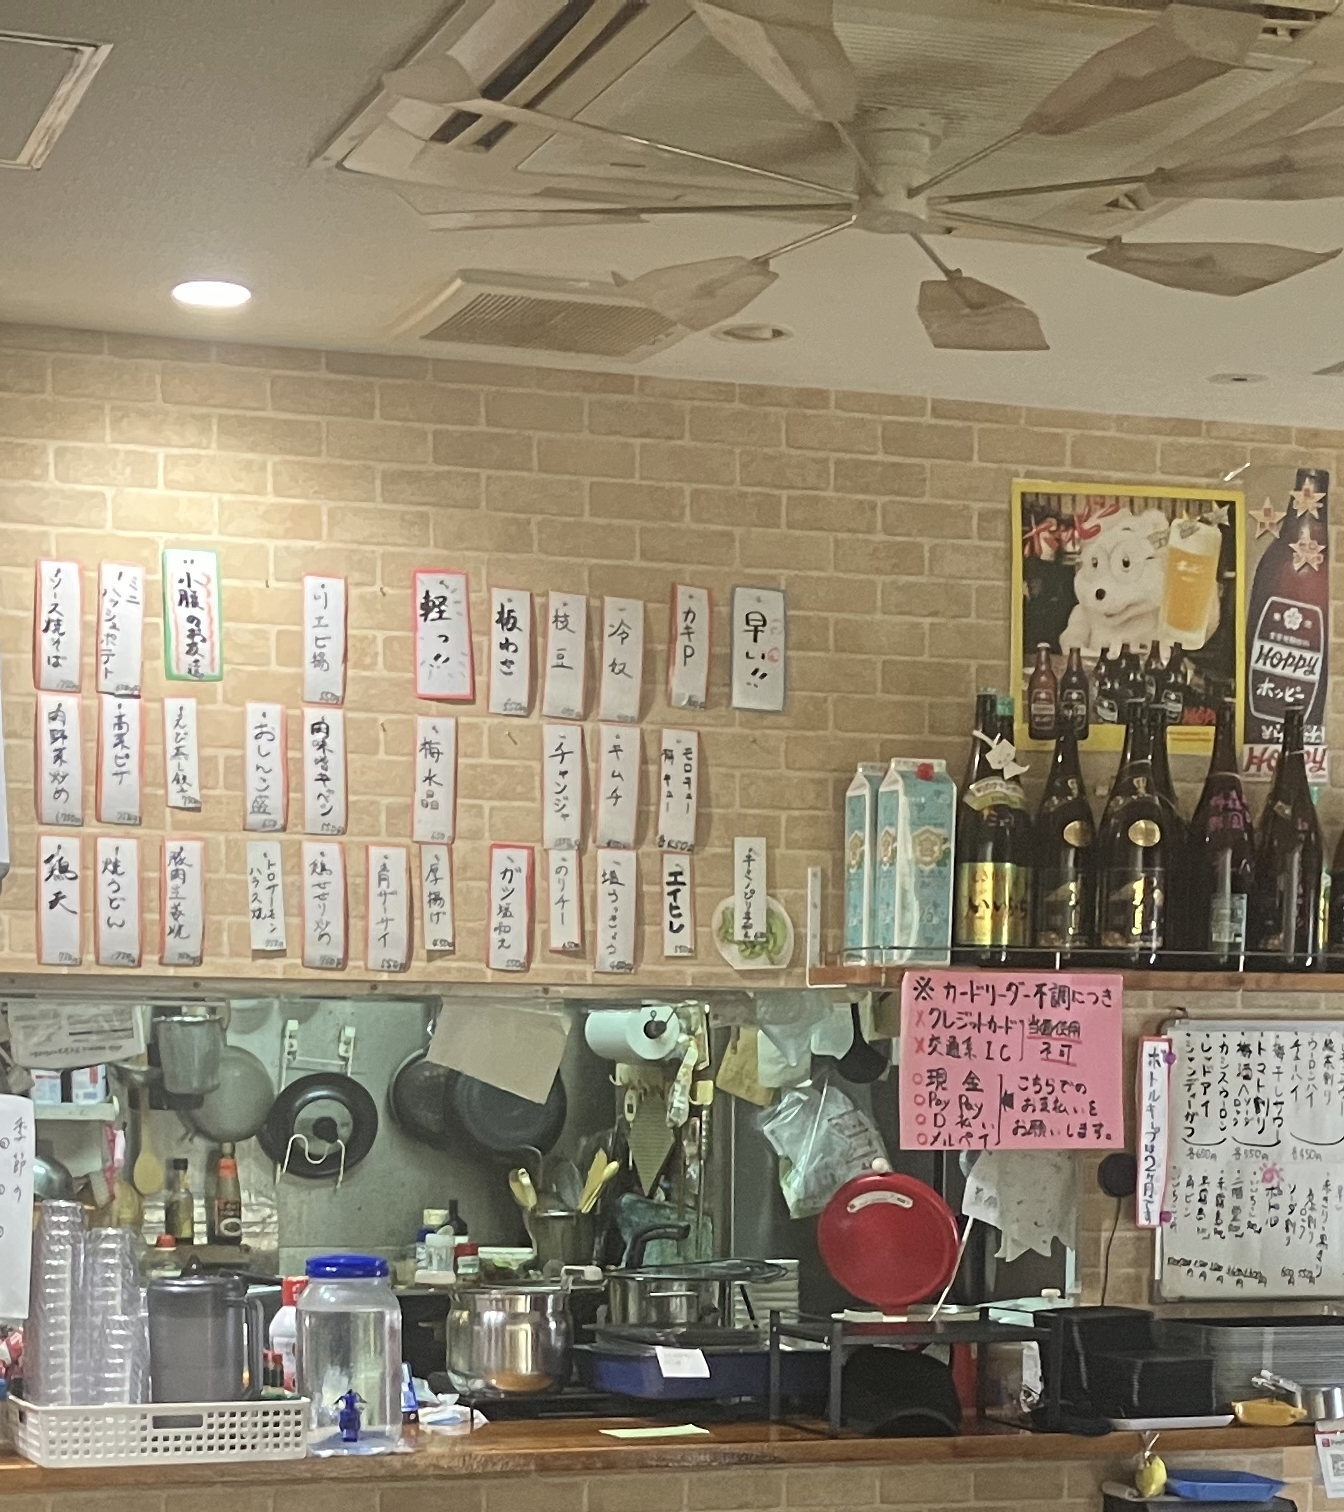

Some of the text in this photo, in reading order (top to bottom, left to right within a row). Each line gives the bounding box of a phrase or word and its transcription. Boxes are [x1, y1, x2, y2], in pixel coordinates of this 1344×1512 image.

[42, 576, 68, 668] ソース焼そば
[494, 601, 523, 676] 板わさ
[551, 608, 576, 670] 枝豆
[607, 618, 633, 680] 冷奴
[1254, 644, 1320, 676] Hoppy
[1256, 677, 1305, 702] ホッピー
[418, 737, 445, 811] 梅水晶
[548, 741, 575, 821] チャンジャ
[605, 743, 625, 808] キムチ
[43, 853, 78, 915] 鶏天
[101, 857, 126, 929] 焼うどん
[425, 867, 447, 926] 厚揚げ
[554, 864, 571, 926] のりチー
[665, 870, 687, 934] エイヒレ
[928, 1007, 1018, 1035] クレジットカード
[925, 1067, 985, 1093] 現金
[1017, 1073, 1088, 1095] こちらでの
[1039, 1042, 1074, 1065] 不可
[1200, 1041, 1214, 1118] レッドアイ
[1236, 1040, 1253, 1081] 梅酒
[1307, 1038, 1319, 1109] ウーロンハイ
[1021, 1096, 1099, 1116] お支払いを
[1183, 1040, 1199, 1138] シャンディーガフ
[1217, 1041, 1230, 1132] カシスウーロン
[13, 1116, 28, 1203] 季節の
[930, 1131, 990, 1148] メルペイ
[1011, 1119, 1113, 1141] お願いします。
